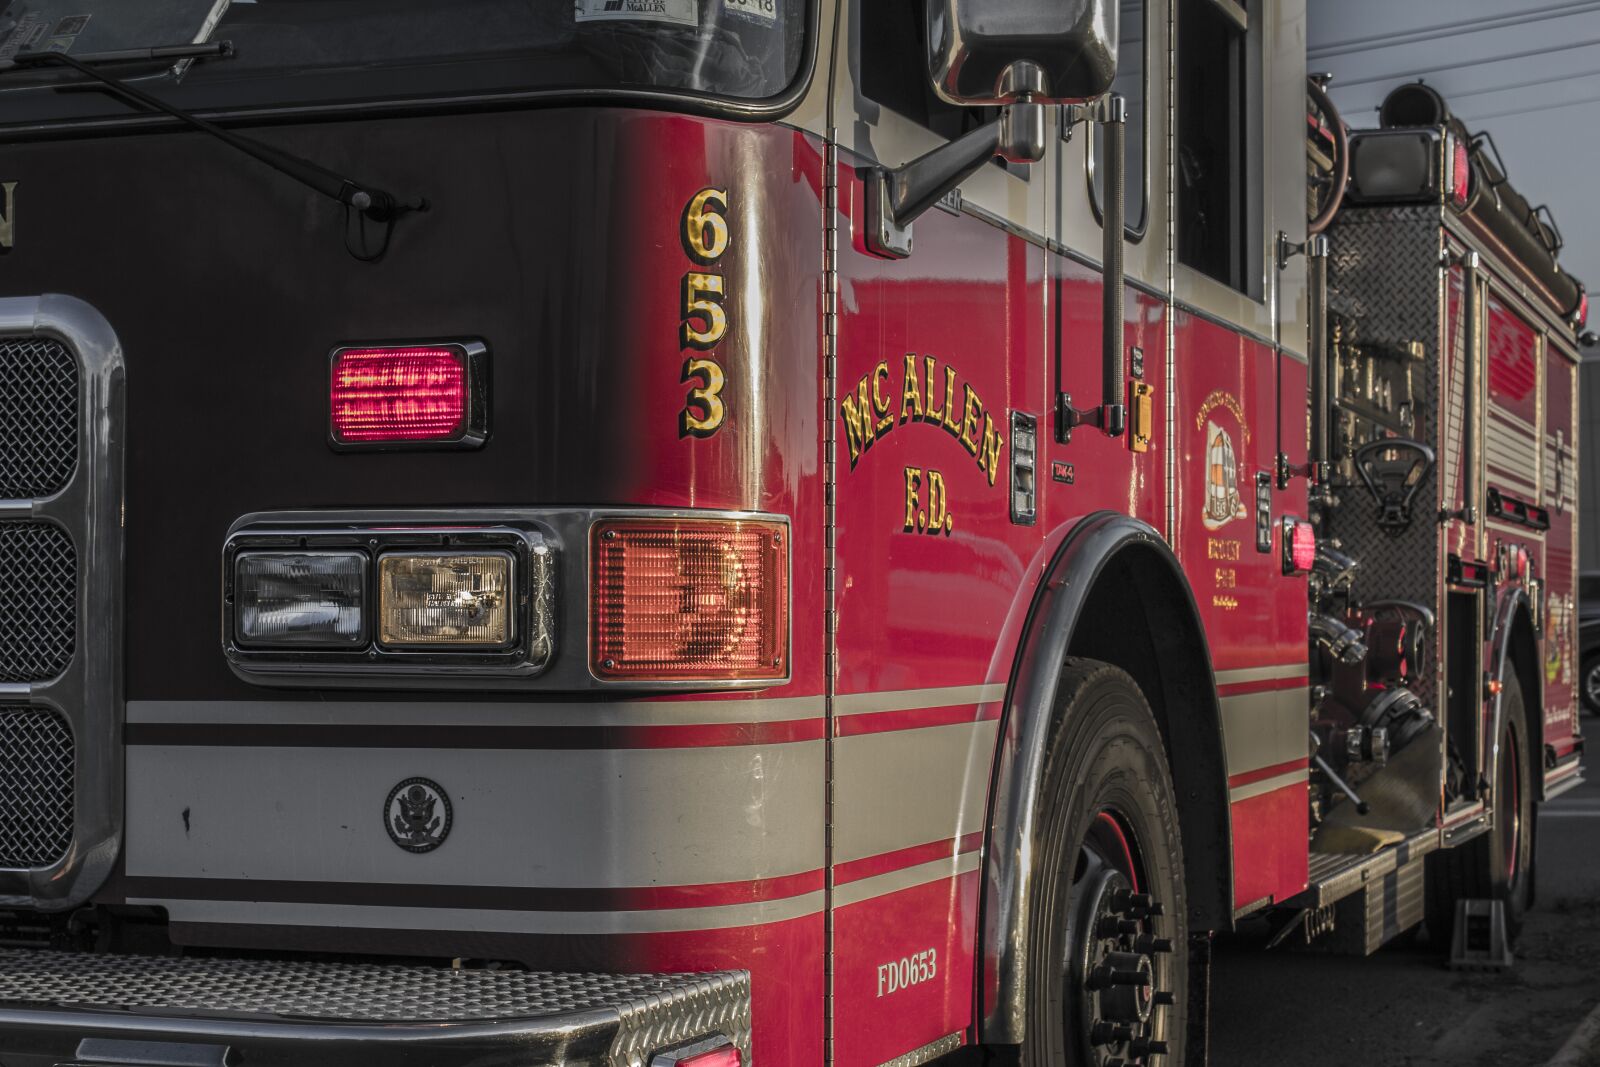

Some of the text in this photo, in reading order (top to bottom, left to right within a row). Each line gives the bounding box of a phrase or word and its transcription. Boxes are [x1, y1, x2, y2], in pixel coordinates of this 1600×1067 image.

[678, 187, 729, 440] 653
[903, 466, 953, 537] F.D.
[876, 947, 937, 998] FD0653
